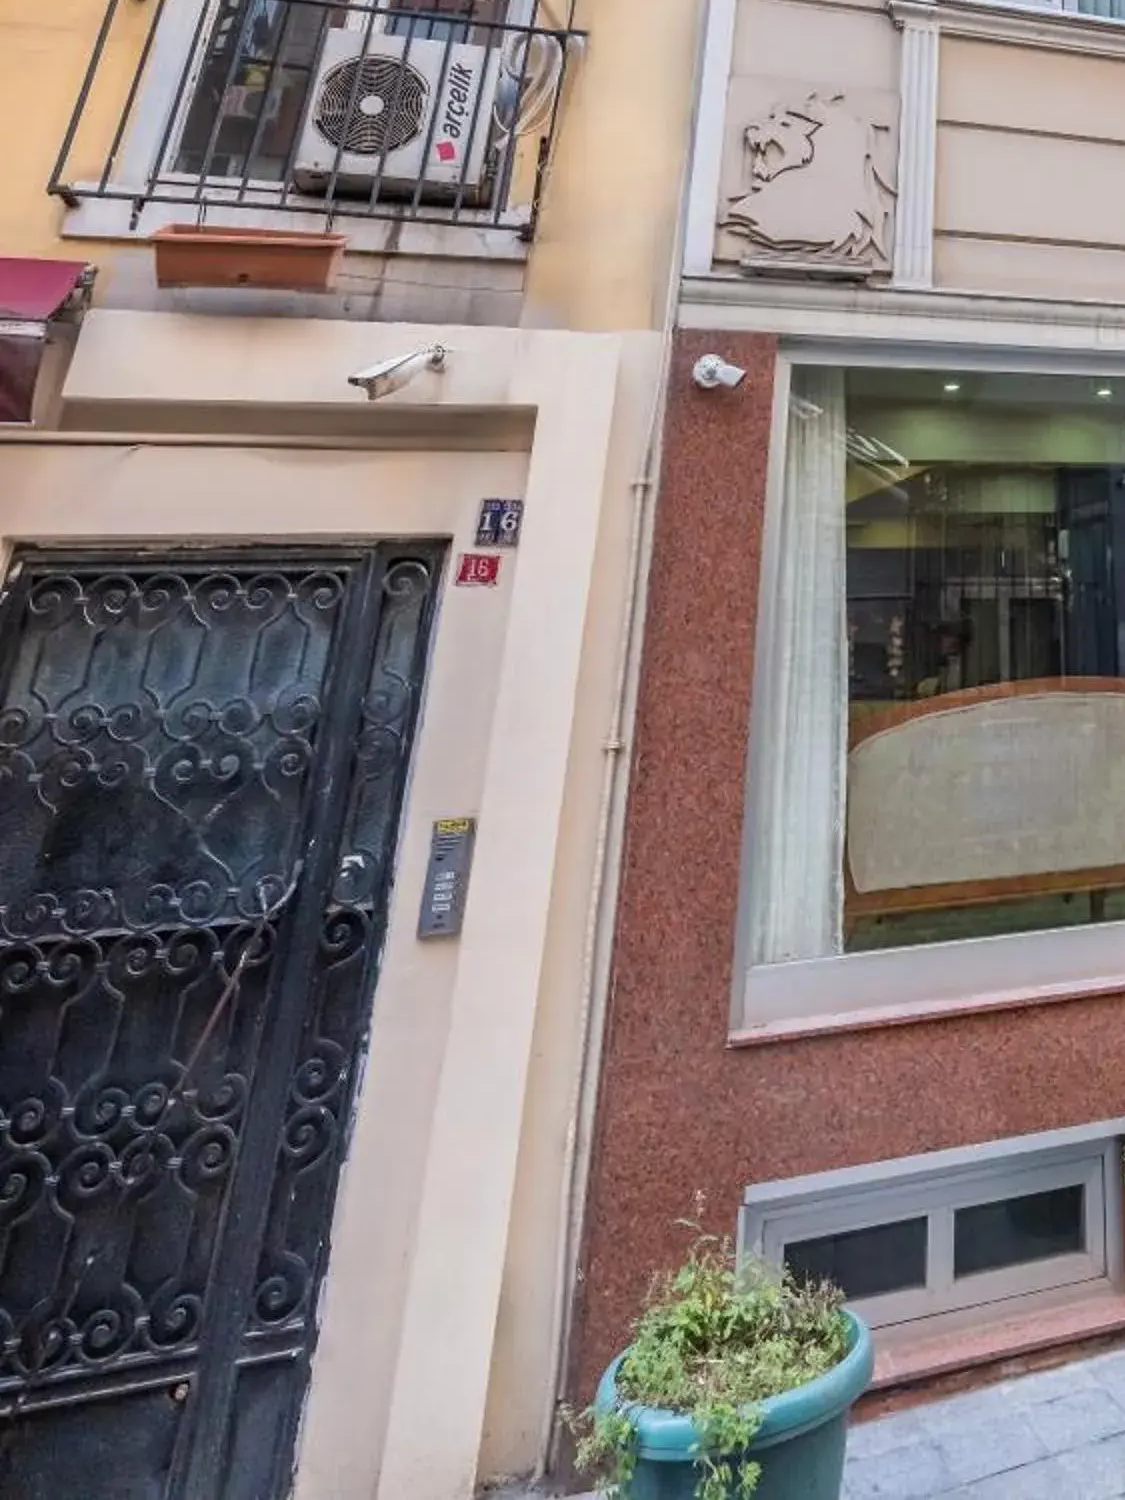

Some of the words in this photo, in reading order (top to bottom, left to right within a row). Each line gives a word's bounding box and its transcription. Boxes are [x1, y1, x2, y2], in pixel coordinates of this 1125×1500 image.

[443, 62, 473, 138] arçelik
[481, 511, 518, 531] 16
[468, 559, 489, 577] 16
